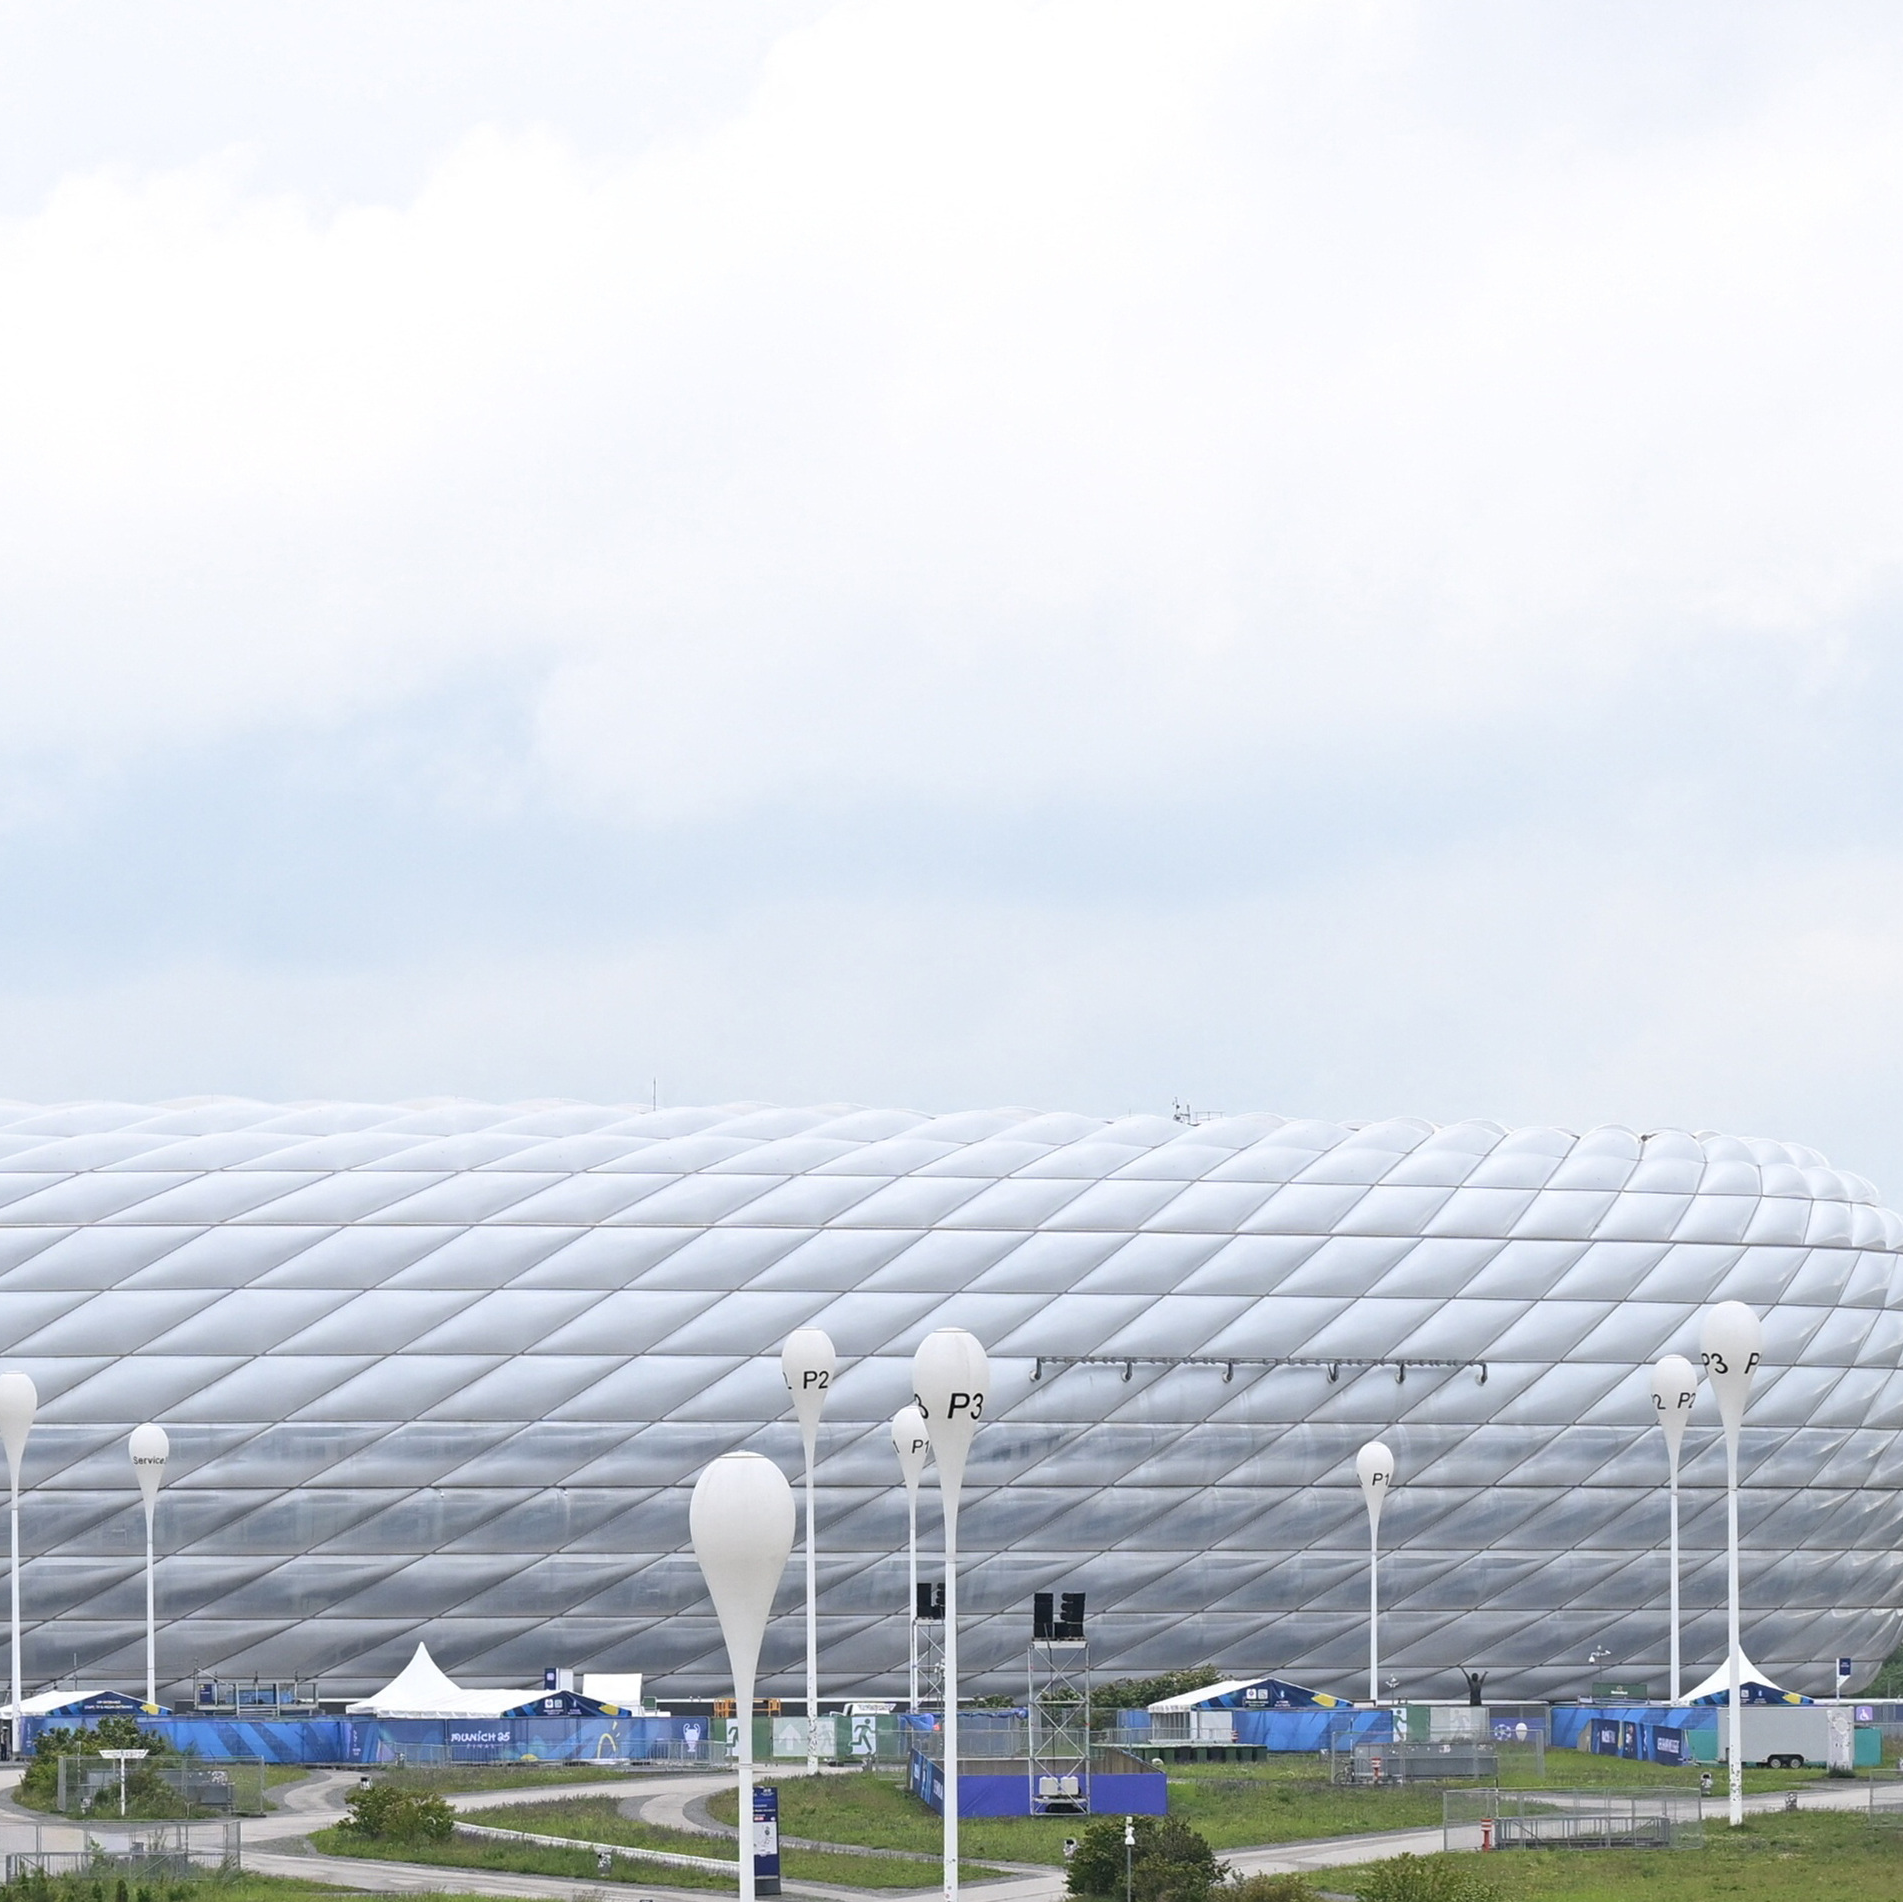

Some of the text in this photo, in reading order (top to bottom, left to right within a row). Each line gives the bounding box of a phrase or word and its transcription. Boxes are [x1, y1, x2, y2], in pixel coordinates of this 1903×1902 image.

[803, 1370, 830, 1390] P2
[947, 1392, 984, 1420] P3
[1677, 1392, 1696, 1409] P2
[911, 1439, 930, 1454] P1
[1371, 1472, 1390, 1487] P1
